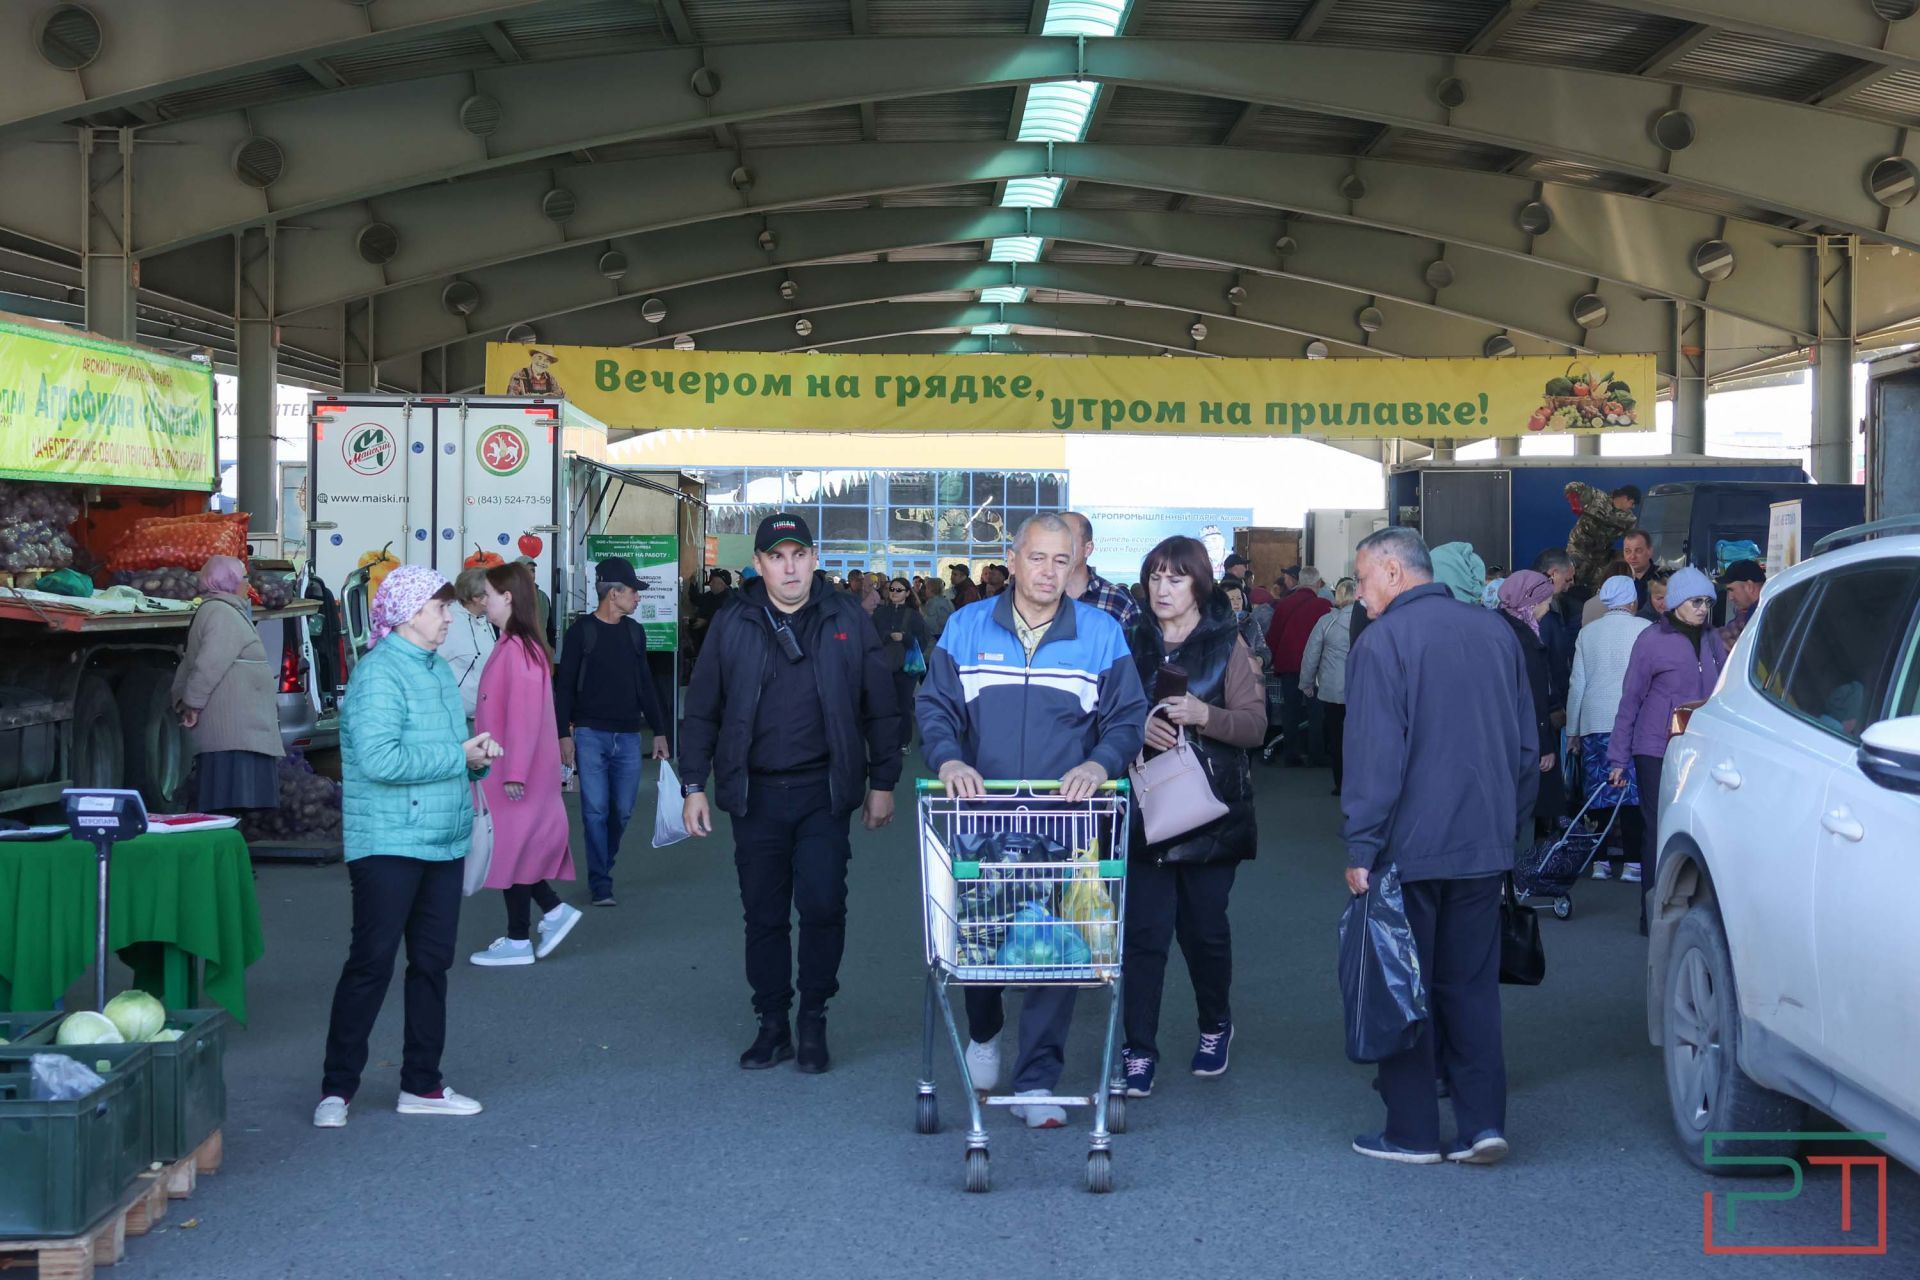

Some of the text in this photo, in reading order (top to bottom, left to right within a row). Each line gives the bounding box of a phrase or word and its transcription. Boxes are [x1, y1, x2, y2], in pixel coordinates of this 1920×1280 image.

[594, 359, 1045, 408] Вечером на грядке,
[1051, 392, 1490, 434] утром на прилавке!
[330, 493, 410, 504] www.maiski.ru
[477, 495, 552, 506] (843) 524-73-59
